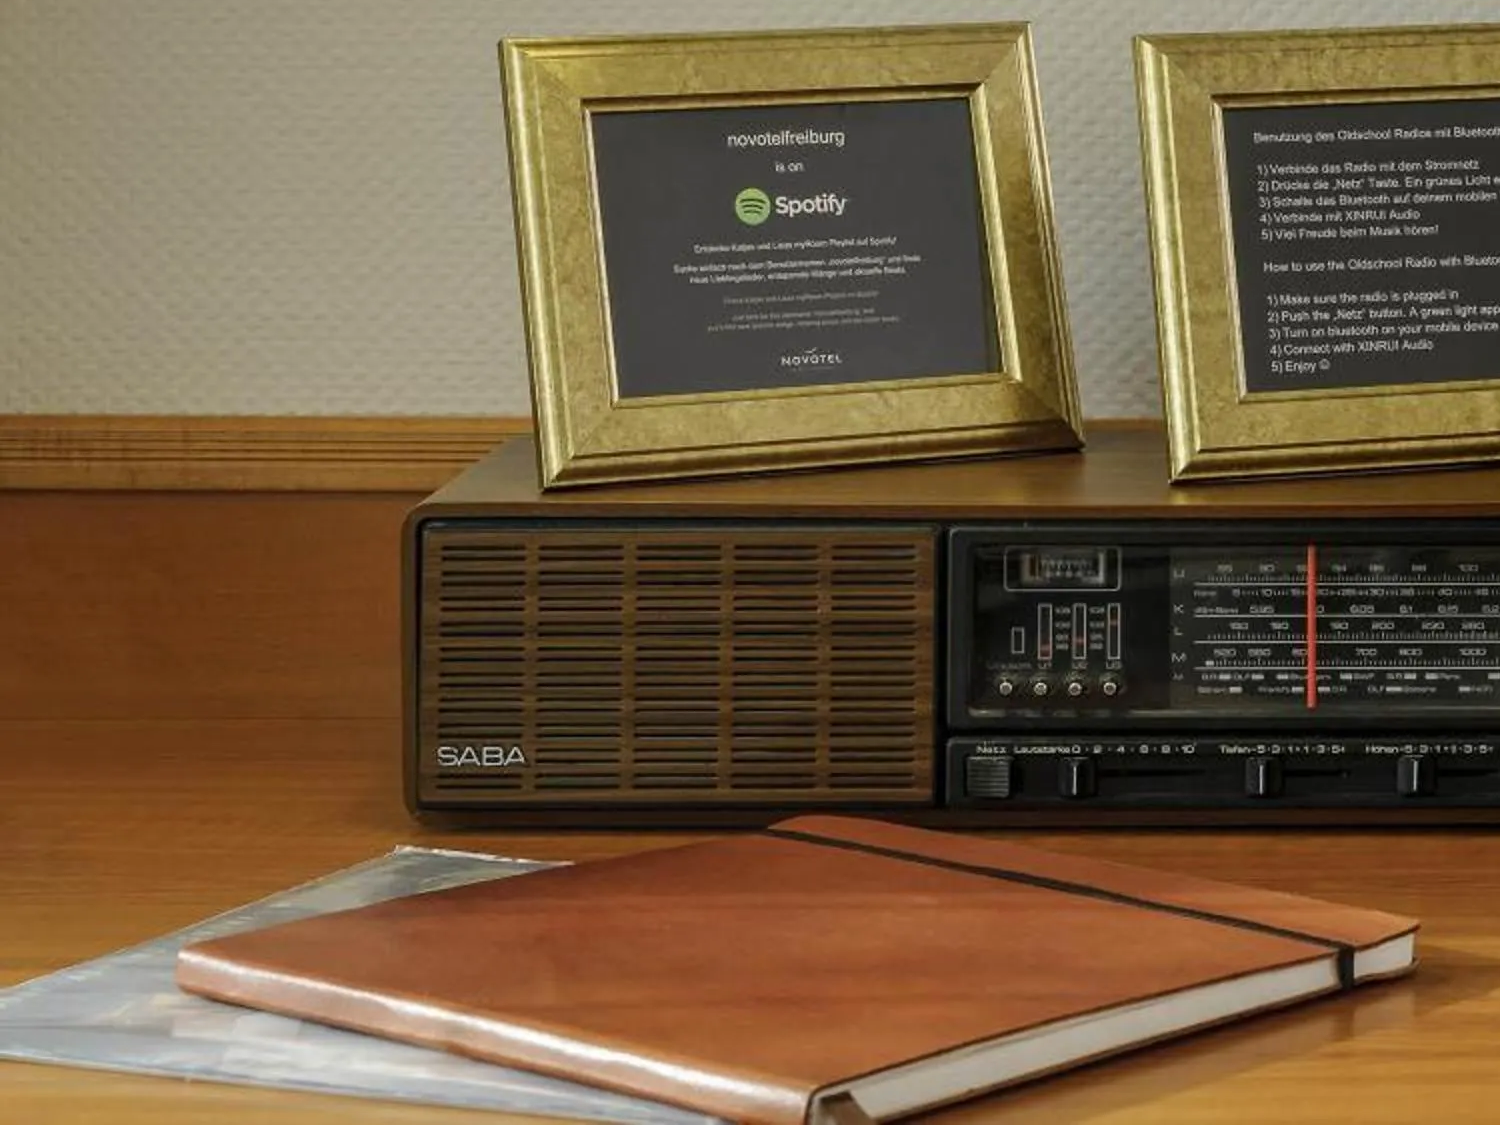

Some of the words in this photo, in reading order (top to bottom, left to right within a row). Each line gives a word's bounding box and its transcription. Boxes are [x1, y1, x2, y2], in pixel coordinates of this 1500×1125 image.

[727, 129, 845, 148] novotelfreiburg
[787, 161, 804, 172] on
[775, 193, 848, 218] Spotify
[781, 354, 843, 366] NOVOTEL
[1284, 359, 1317, 374] Enjoy
[1173, 604, 1184, 614] K
[437, 746, 526, 767] SABA
